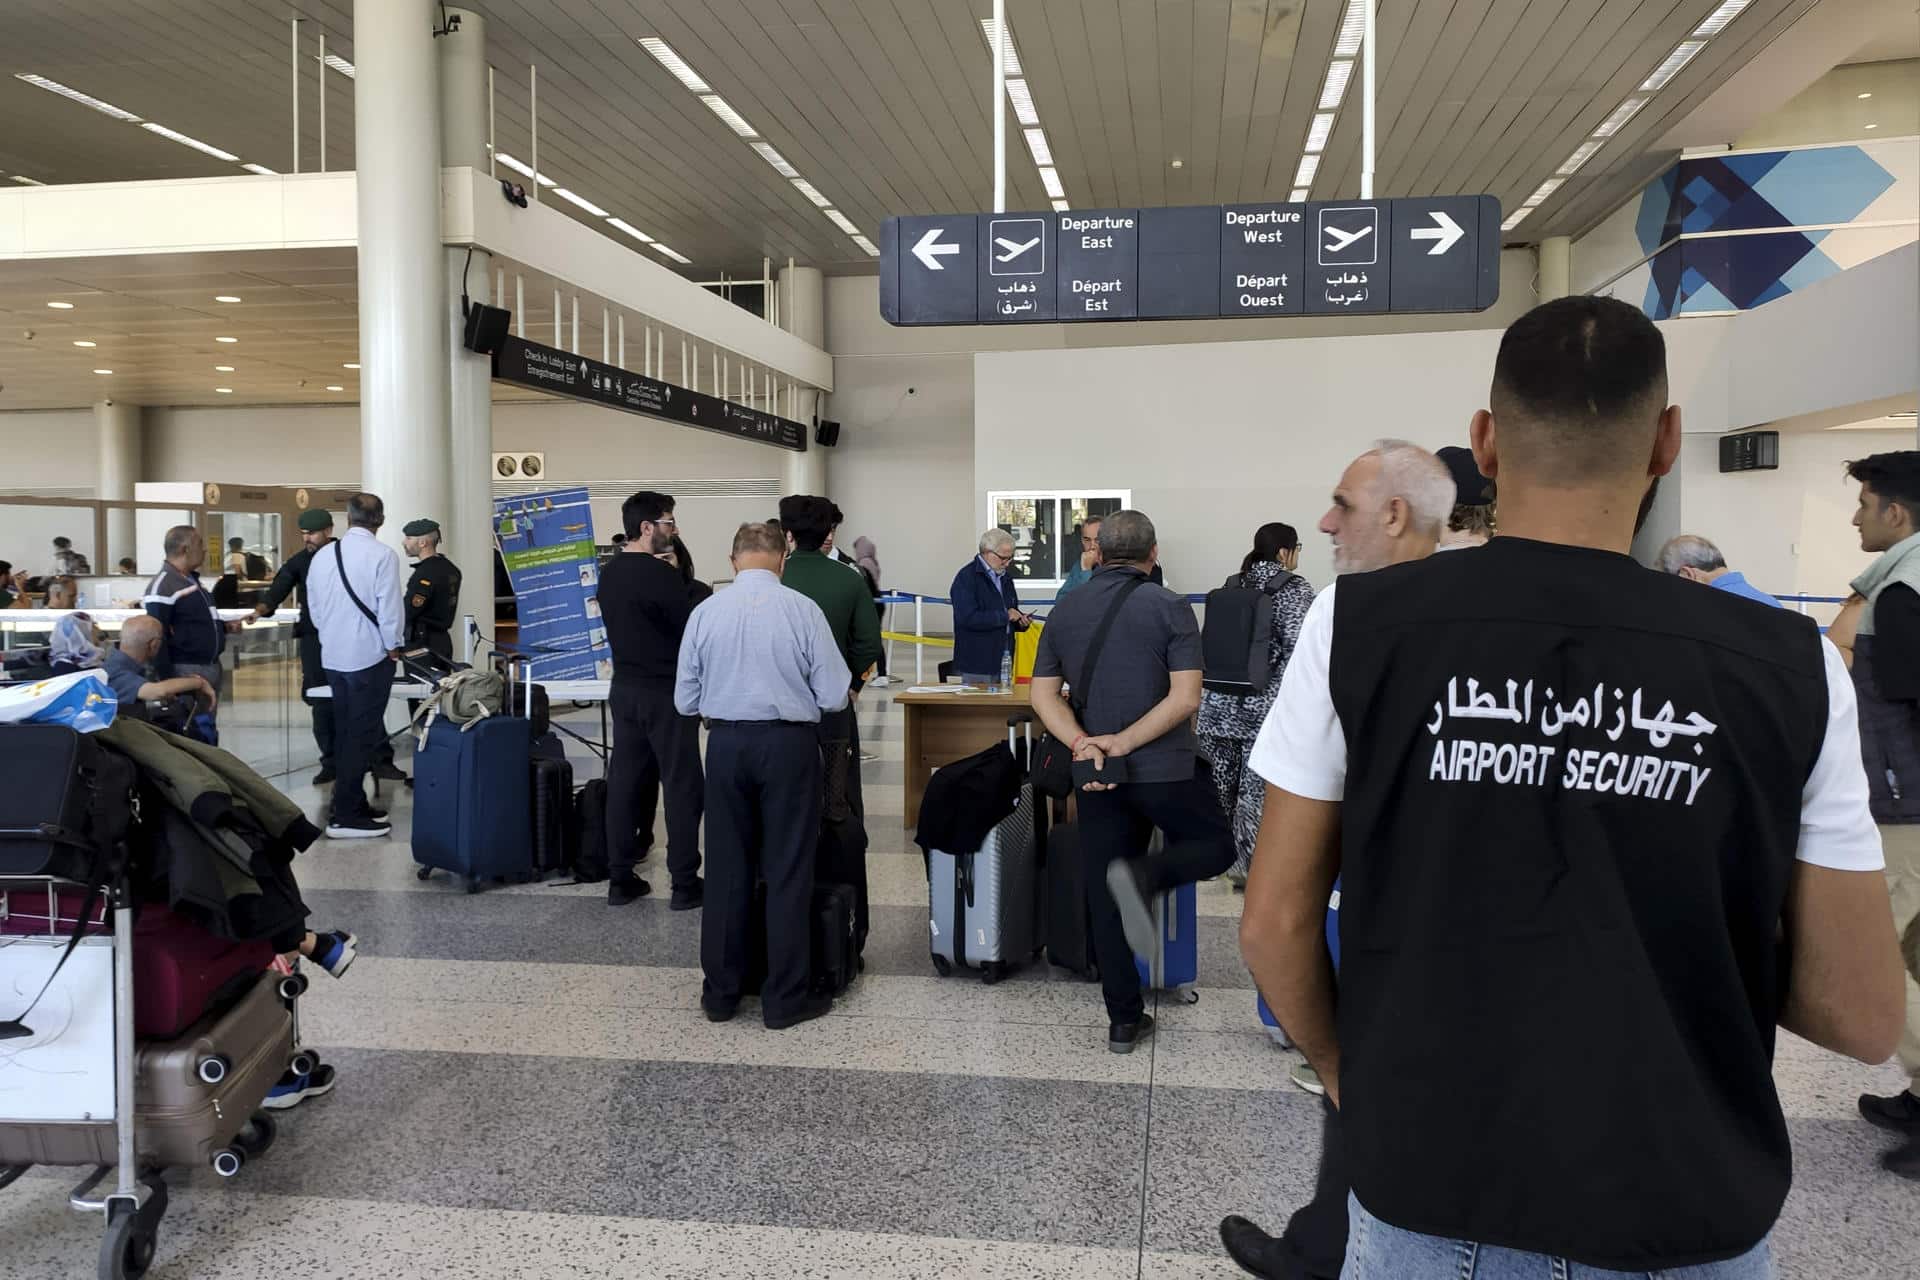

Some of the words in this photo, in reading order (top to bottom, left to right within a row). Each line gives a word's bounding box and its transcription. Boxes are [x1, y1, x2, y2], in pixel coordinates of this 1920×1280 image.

[1062, 216, 1134, 232] Departure
[1226, 211, 1300, 227] Departure
[1081, 236, 1113, 249] East
[1244, 230, 1283, 243] West
[1072, 279, 1122, 294] Départ
[1236, 274, 1288, 290] Départ
[1326, 271, 1368, 287] ذهاب
[997, 281, 1036, 295] ذهاب
[1085, 298, 1109, 311] Est
[1240, 293, 1285, 306] Ouest
[1426, 675, 1534, 736] المطار
[1606, 687, 1718, 756] جهاز
[1429, 740, 1555, 785] AIRPORT
[1562, 748, 1712, 806] SECURITY
